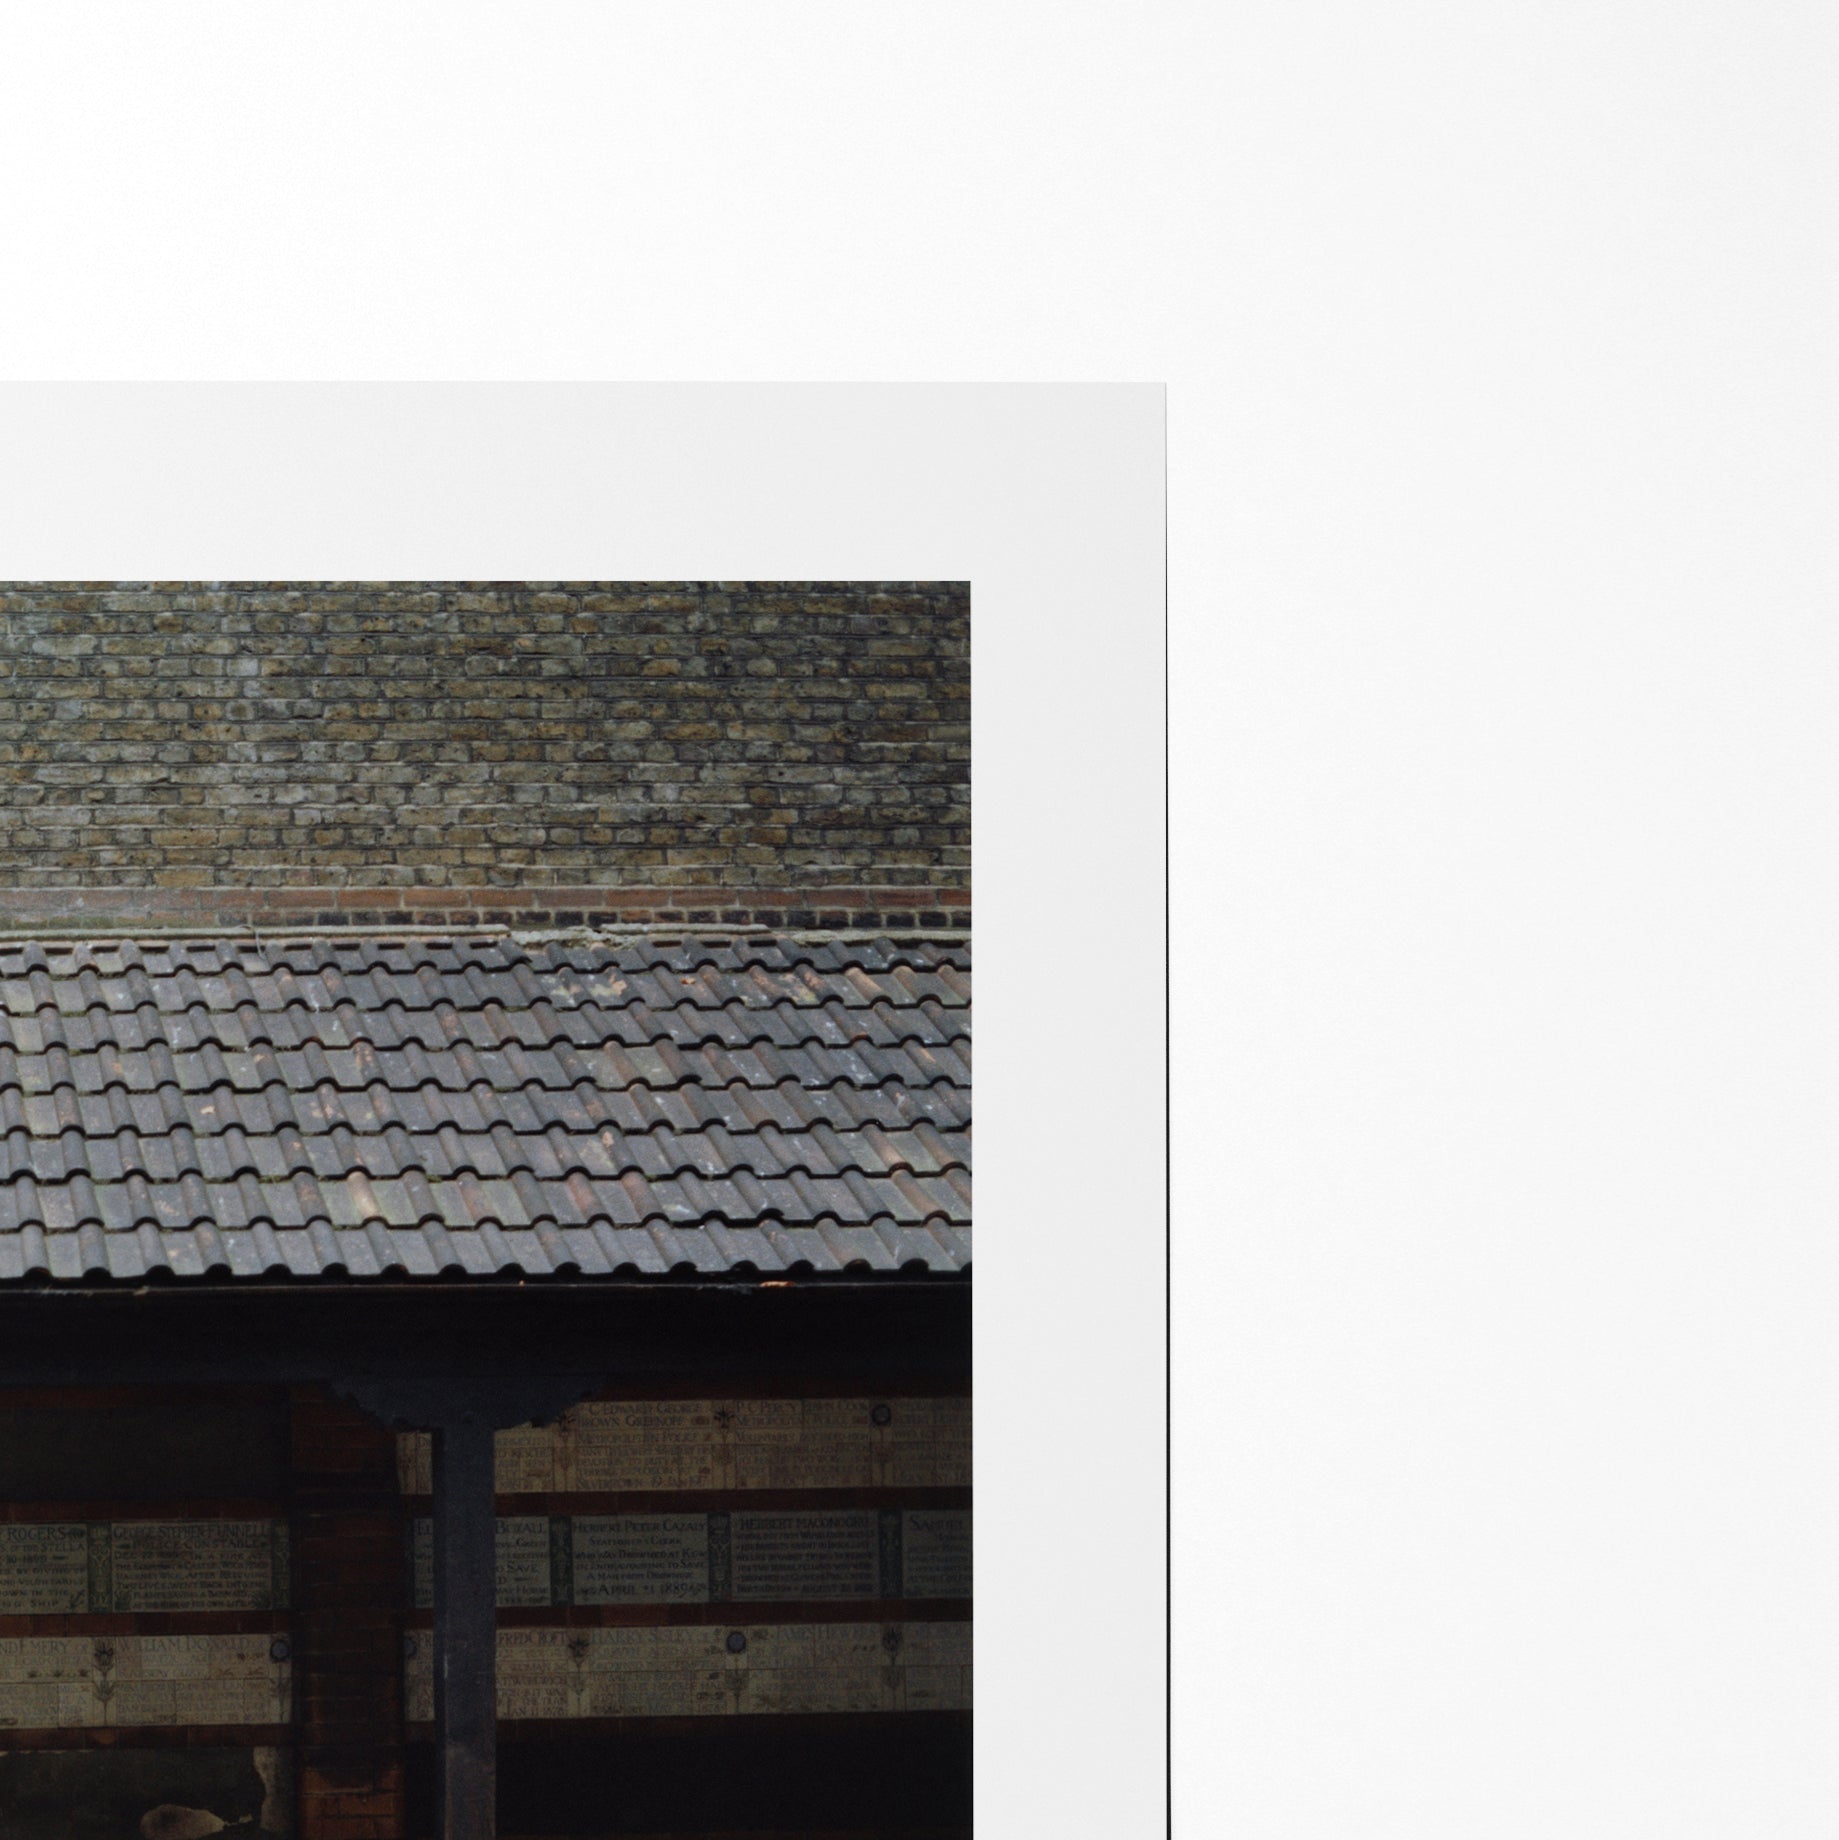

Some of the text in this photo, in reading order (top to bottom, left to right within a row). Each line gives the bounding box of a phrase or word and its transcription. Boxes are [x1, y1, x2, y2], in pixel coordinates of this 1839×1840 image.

[8, 1527, 66, 1542] ROGERS
[41, 1543, 85, 1552] STELLA
[507, 1561, 539, 1573] SAVE
[599, 1584, 635, 1595] APRIL
